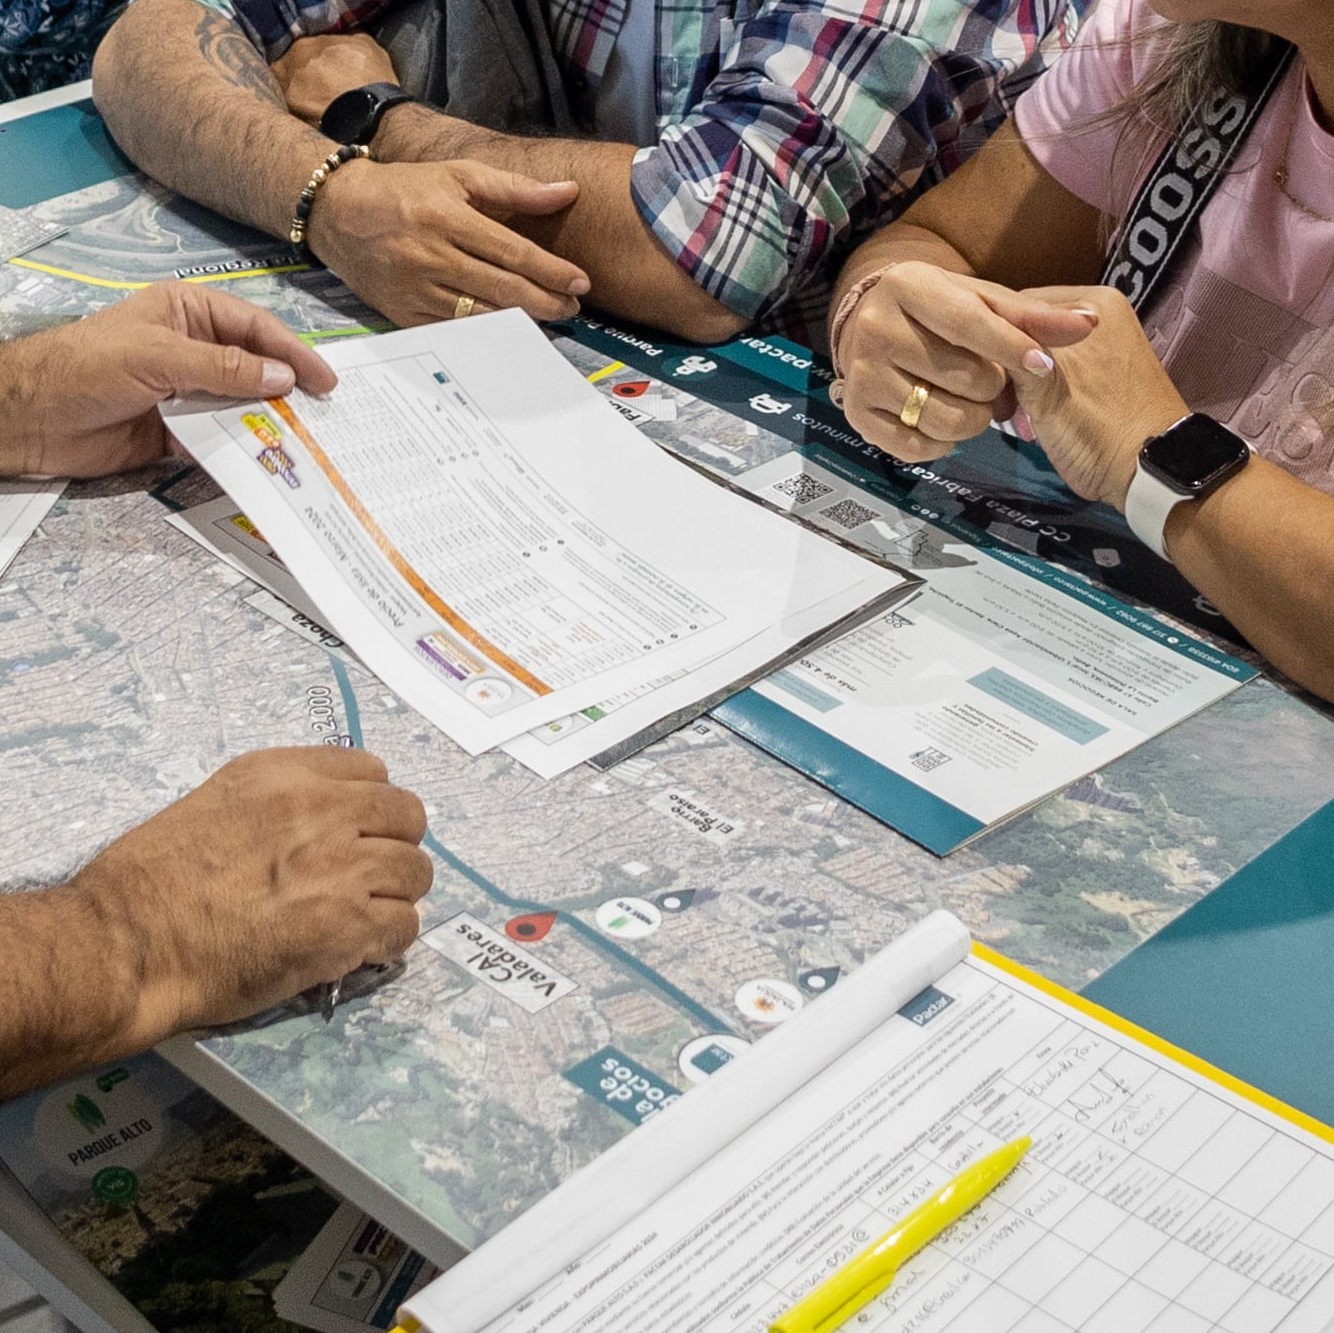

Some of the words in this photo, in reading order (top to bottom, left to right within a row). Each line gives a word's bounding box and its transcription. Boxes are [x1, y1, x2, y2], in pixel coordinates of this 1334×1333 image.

[603, 325, 663, 357] Parque
[790, 406, 864, 455] minutos
[982, 494, 1040, 533] Plaza
[1037, 520, 1072, 547] CC
[375, 599, 404, 627] Precio
[291, 611, 343, 650] Choza
[819, 671, 838, 681] de
[834, 679, 859, 693] más
[1065, 676, 1107, 699] NEGOCIOS
[304, 682, 337, 736] 2.000
[1104, 697, 1118, 705] DE
[1115, 703, 1139, 716] SALA
[939, 704, 980, 727] generando
[961, 702, 1011, 730] comunidades.
[1008, 728, 1040, 746] creando
[673, 806, 711, 832] Barrio
[452, 920, 557, 997] Valadares
[466, 949, 514, 986] CAI
[912, 991, 951, 1026] Pactar
[594, 1072, 635, 1105] de
[68, 1133, 122, 1165] PARQUE
[120, 1117, 152, 1142] ALTO
